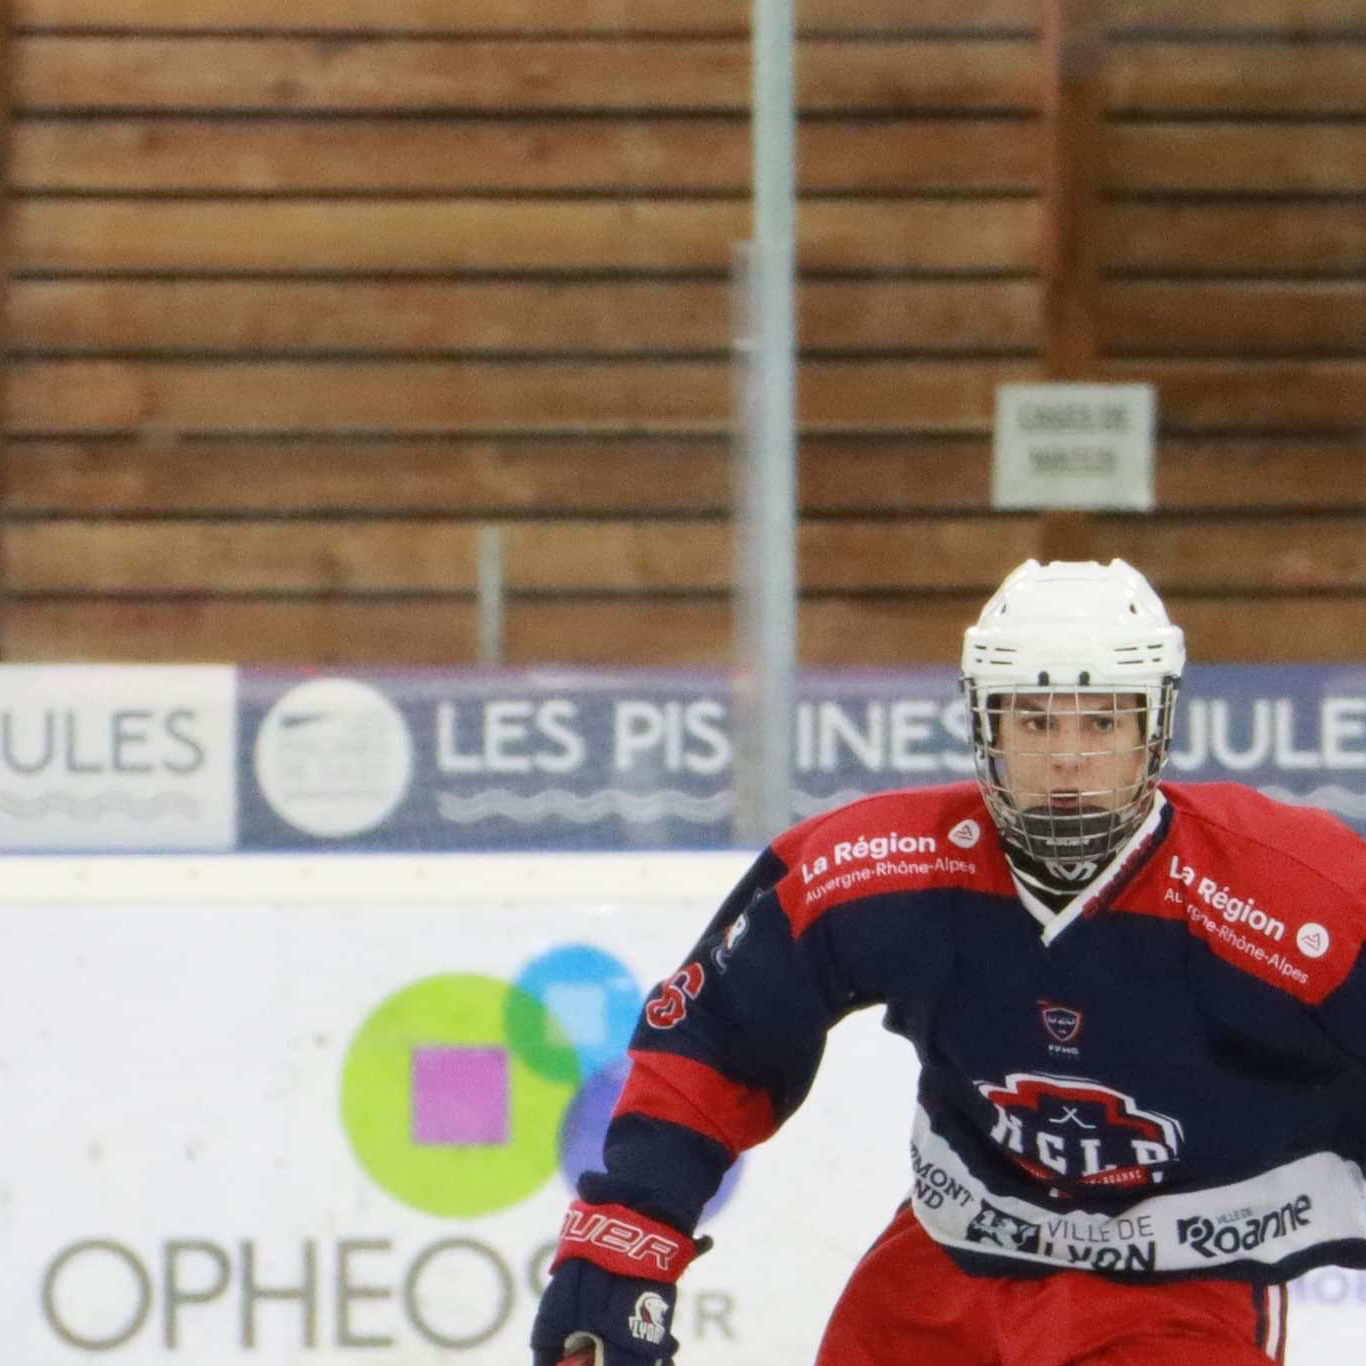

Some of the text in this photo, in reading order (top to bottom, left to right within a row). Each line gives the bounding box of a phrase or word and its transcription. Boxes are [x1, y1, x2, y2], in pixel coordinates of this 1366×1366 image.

[1, 707, 207, 775] ULES
[439, 698, 585, 774] LES
[615, 698, 975, 773] PISINES
[801, 831, 937, 884] La Région
[804, 856, 977, 904] Auvergne-Rhône-Alpes
[1169, 855, 1286, 942] La Région
[1164, 887, 1309, 985] Aurgne-Rhône-Alpes
[564, 1210, 679, 1271] UER
[1046, 1215, 1155, 1243] VILLE DE
[1176, 1194, 1313, 1259] Roanne
